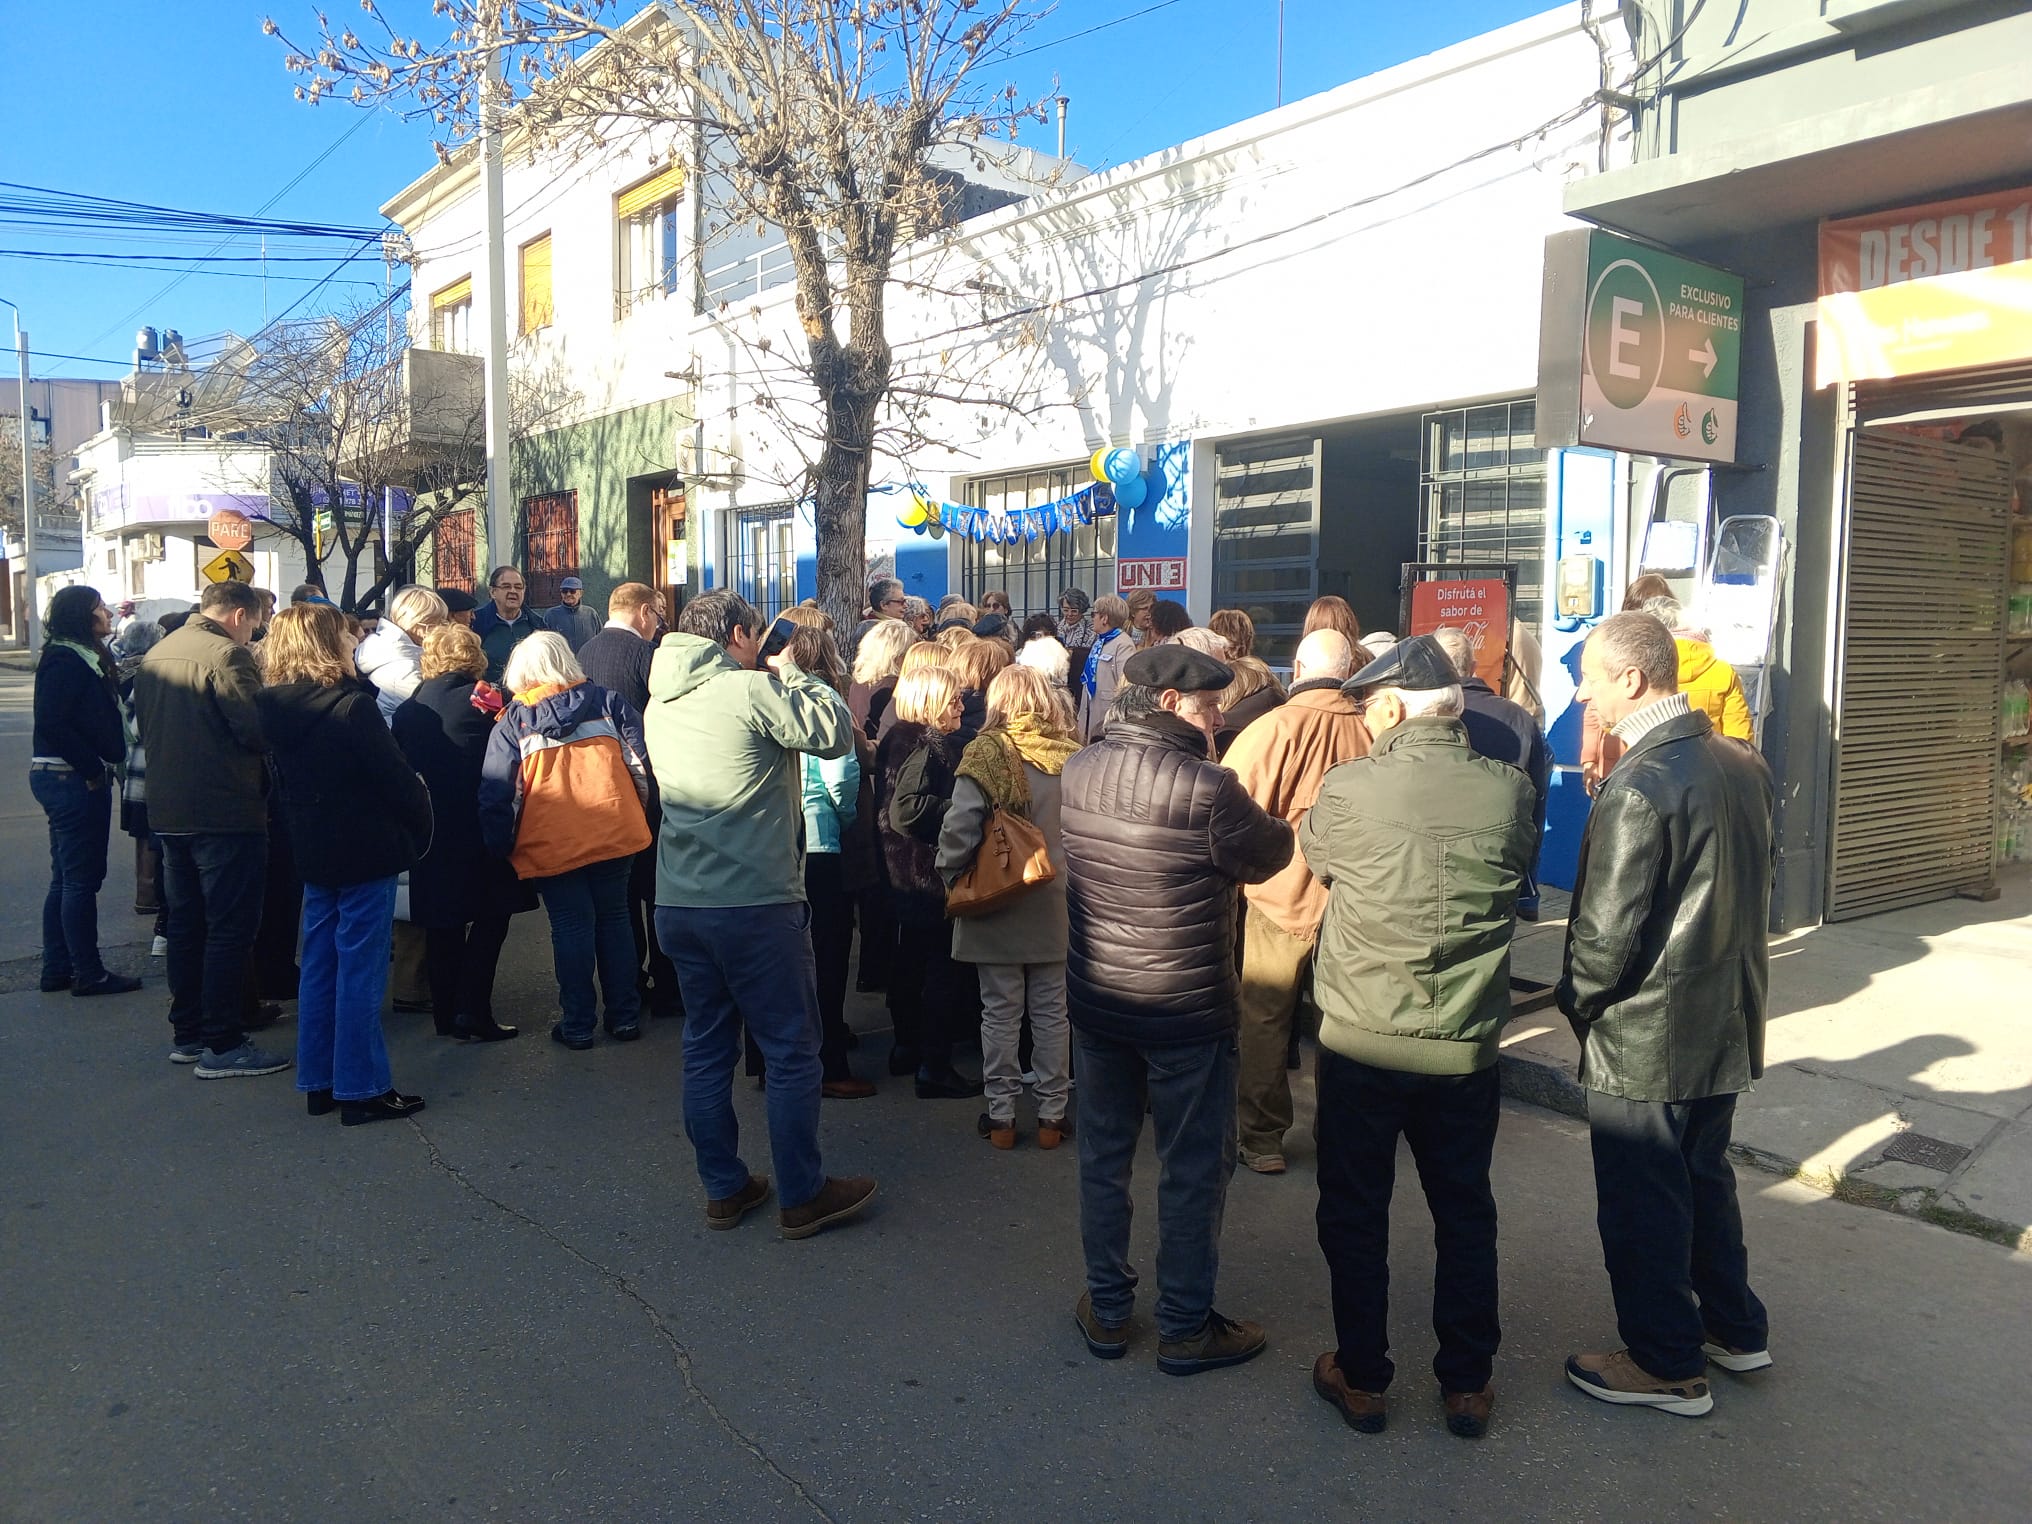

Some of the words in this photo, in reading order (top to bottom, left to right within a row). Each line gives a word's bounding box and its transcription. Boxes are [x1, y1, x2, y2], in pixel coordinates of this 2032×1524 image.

[1860, 209, 1995, 290] DESDE
[2006, 202, 2032, 262] 1
[1681, 284, 1731, 310] EXCLUSIVO
[1669, 302, 1695, 321] PARA
[1697, 310, 1739, 331] CLIENTES
[1609, 295, 1644, 380] E
[211, 521, 249, 538] PARE
[1121, 563, 1161, 586] UNI
[1437, 586, 1475, 600] Disfrutá
[1477, 587, 1486, 599] el
[1440, 604, 1468, 617] sabor
[1470, 604, 1482, 616] de
